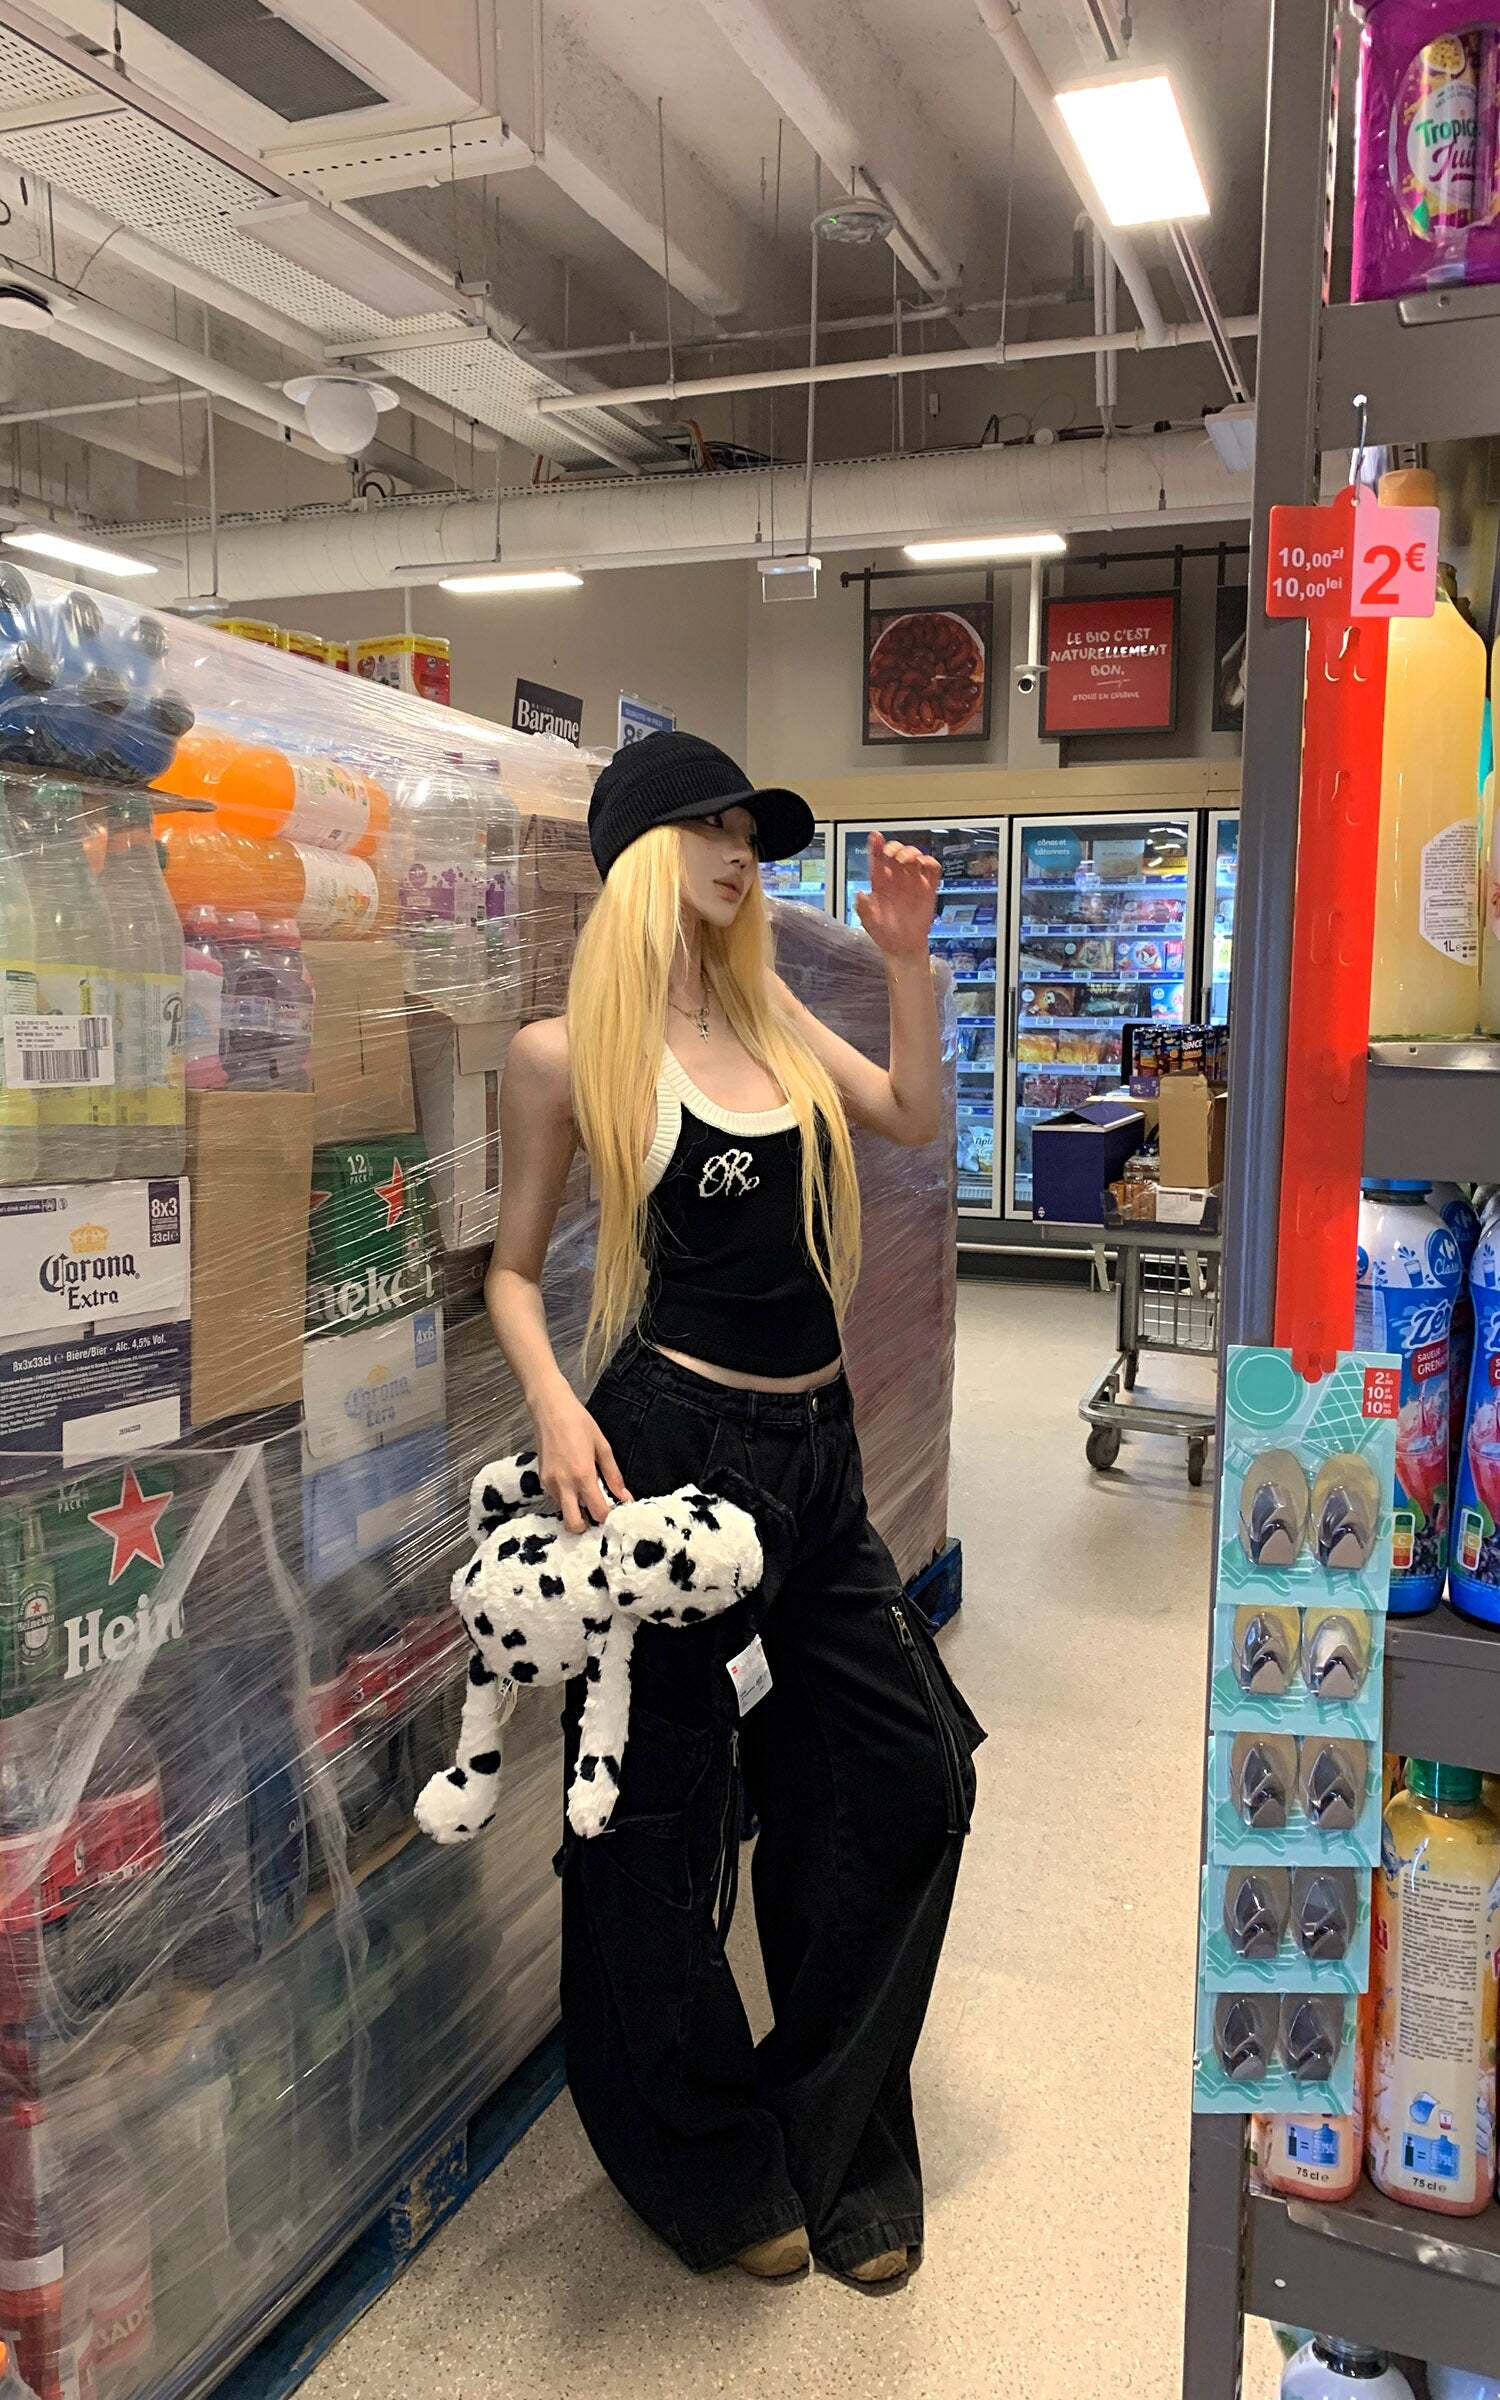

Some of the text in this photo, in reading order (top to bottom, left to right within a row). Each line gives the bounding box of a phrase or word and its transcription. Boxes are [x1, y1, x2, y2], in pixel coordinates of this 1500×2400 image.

[1066, 627, 1152, 645] LE BIO C'EST
[1050, 643, 1168, 662] NATURELLEMENT
[1090, 665, 1125, 677] BON.
[517, 698, 579, 741] Baranne
[1443, 940, 1456, 953] 1L
[346, 1153, 367, 1176] 12
[350, 1174, 368, 1184] PACK
[151, 1196, 178, 1218] 8x3
[151, 1231, 170, 1243] 33cl
[39, 1252, 137, 1296] Corona
[68, 1285, 120, 1311] Extra
[415, 1326, 435, 1346] 4x6
[58, 1500, 82, 1514] PACK
[1296, 2166, 1320, 2182] 75 cl
[1412, 2177, 1437, 2192] 75 cl
